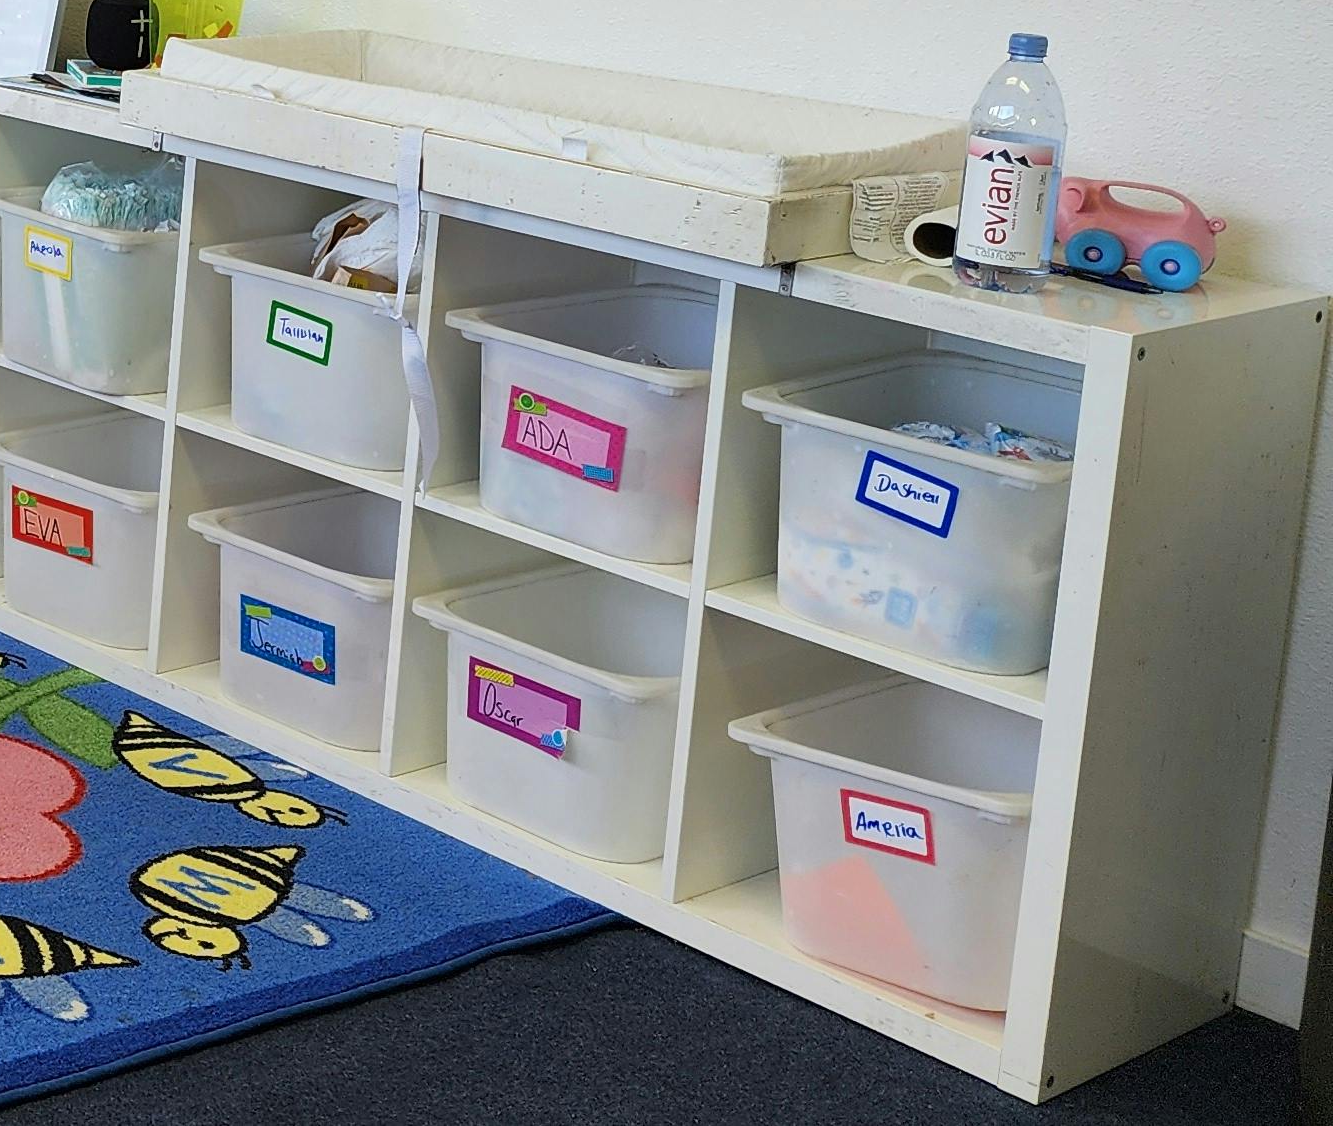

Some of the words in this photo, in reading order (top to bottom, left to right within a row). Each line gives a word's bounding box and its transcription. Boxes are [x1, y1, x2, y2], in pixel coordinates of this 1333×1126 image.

[984, 167, 1015, 245] evian
[521, 416, 574, 461] ADA
[24, 507, 63, 547] EVA
[483, 682, 524, 728] Oscar
[856, 811, 925, 840] Amelia
